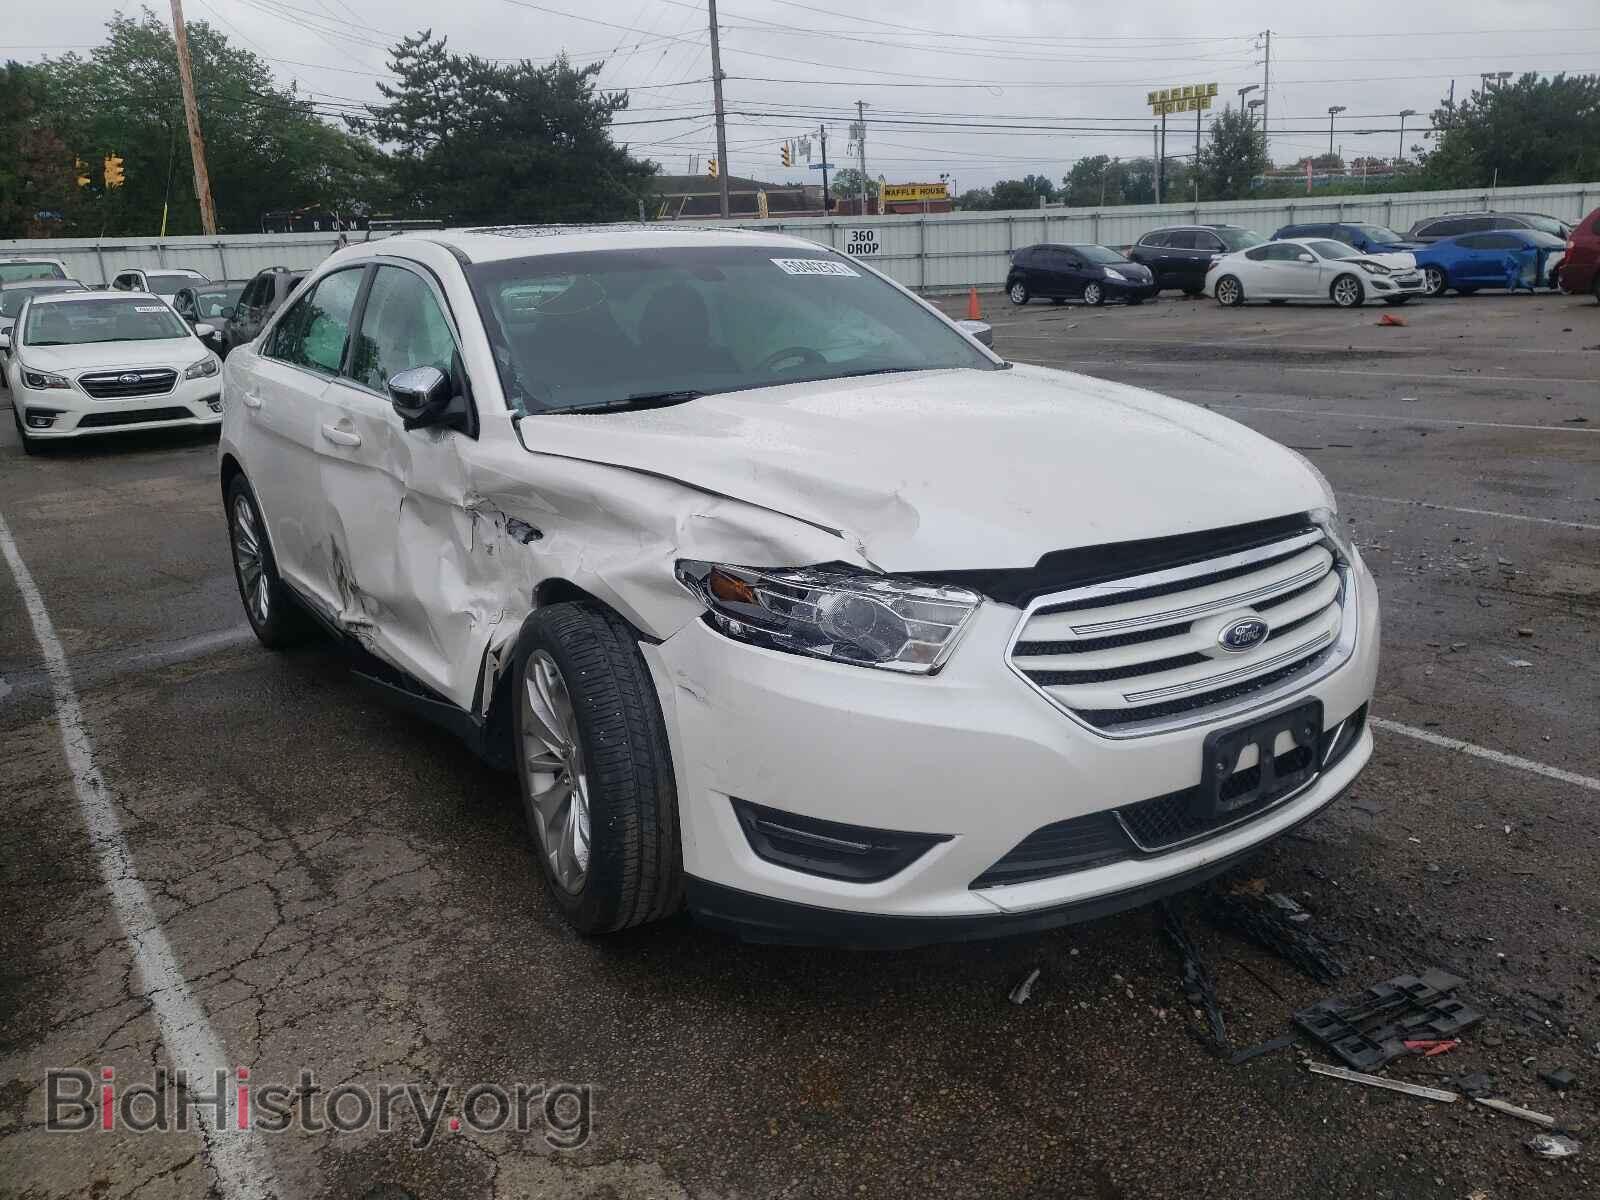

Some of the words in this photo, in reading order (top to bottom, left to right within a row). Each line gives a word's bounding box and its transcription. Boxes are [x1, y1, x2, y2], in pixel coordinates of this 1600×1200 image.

[1148, 84, 1217, 104] WAFFLE
[1153, 98, 1211, 115] HOUSE
[885, 188, 916, 196] WAFFLE
[852, 231, 874, 241] 360
[847, 243, 879, 254] DROP
